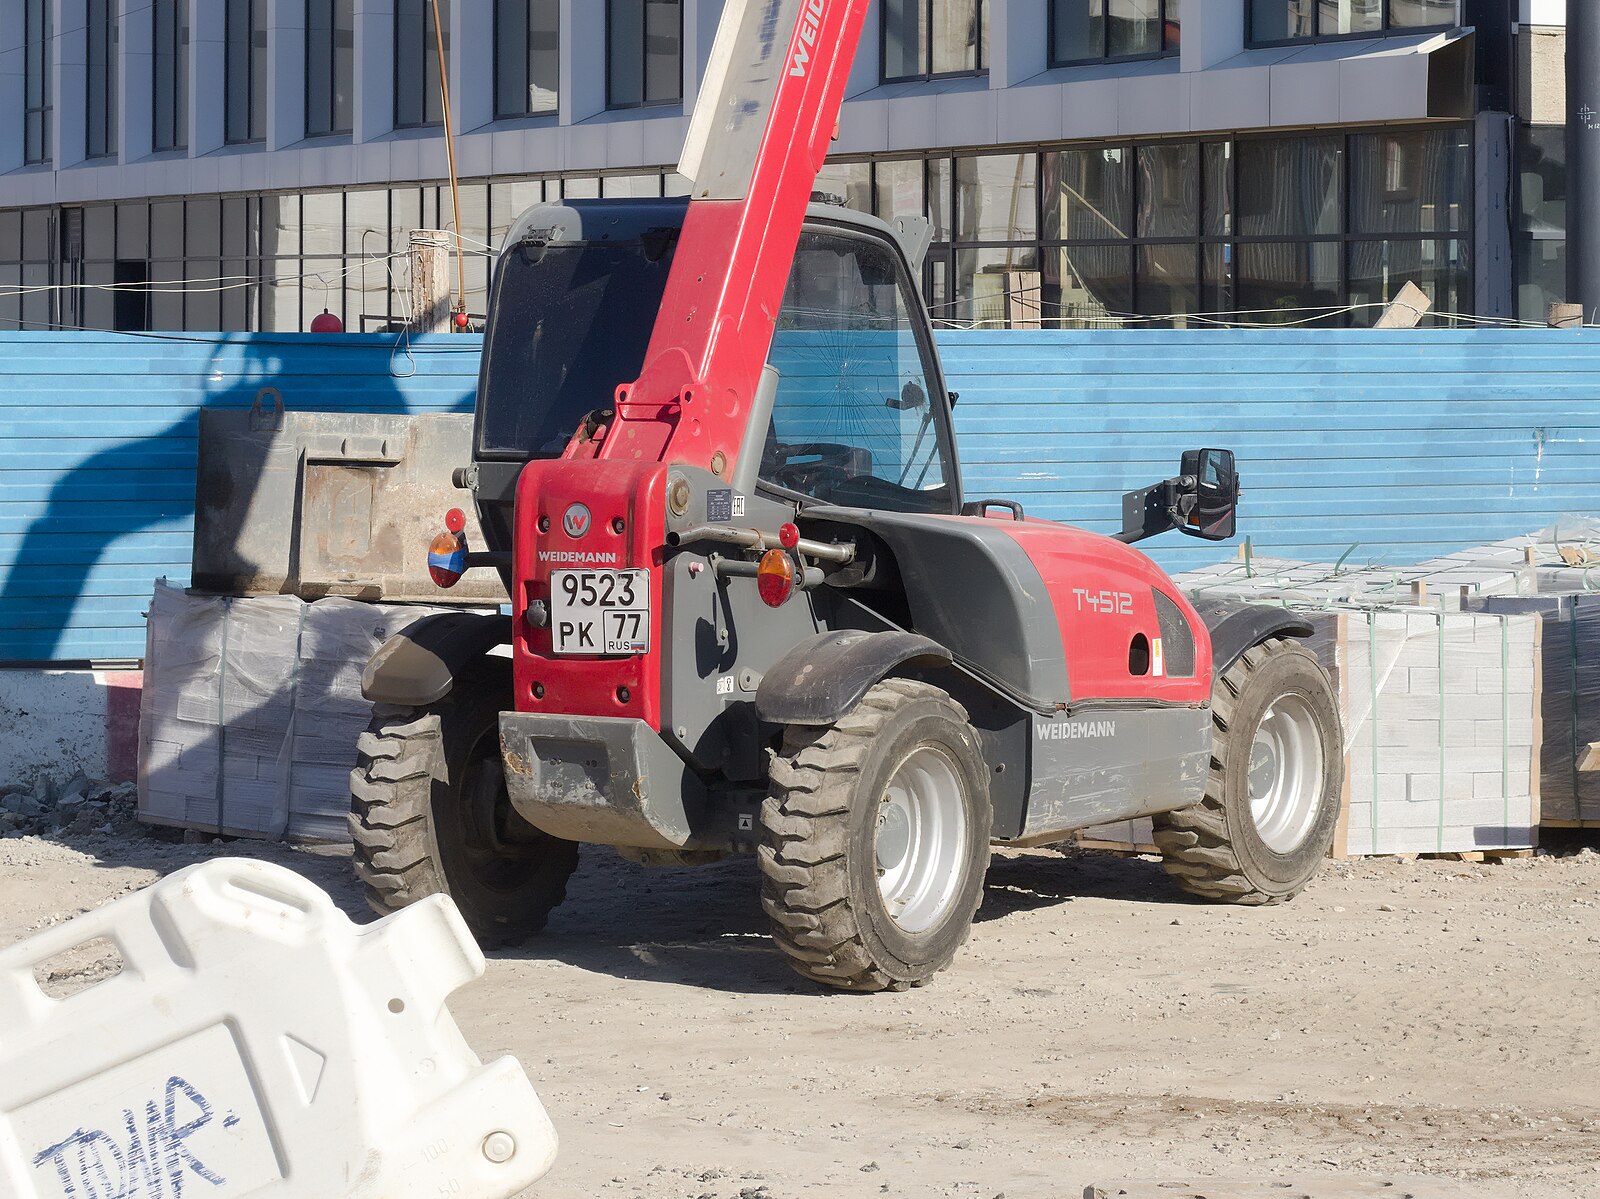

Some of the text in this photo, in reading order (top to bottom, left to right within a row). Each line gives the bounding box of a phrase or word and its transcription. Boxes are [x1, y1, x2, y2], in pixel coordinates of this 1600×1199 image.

[539, 551, 617, 563] WEIDEMANN
[562, 574, 635, 607] 9523
[1072, 588, 1134, 615] T4512
[559, 622, 595, 647] PK
[613, 614, 641, 639] 77
[608, 641, 630, 651] RUS
[1036, 720, 1116, 741] WEIDEMANN
[422, 1138, 449, 1163] 100
[437, 1178, 461, 1199] 50
